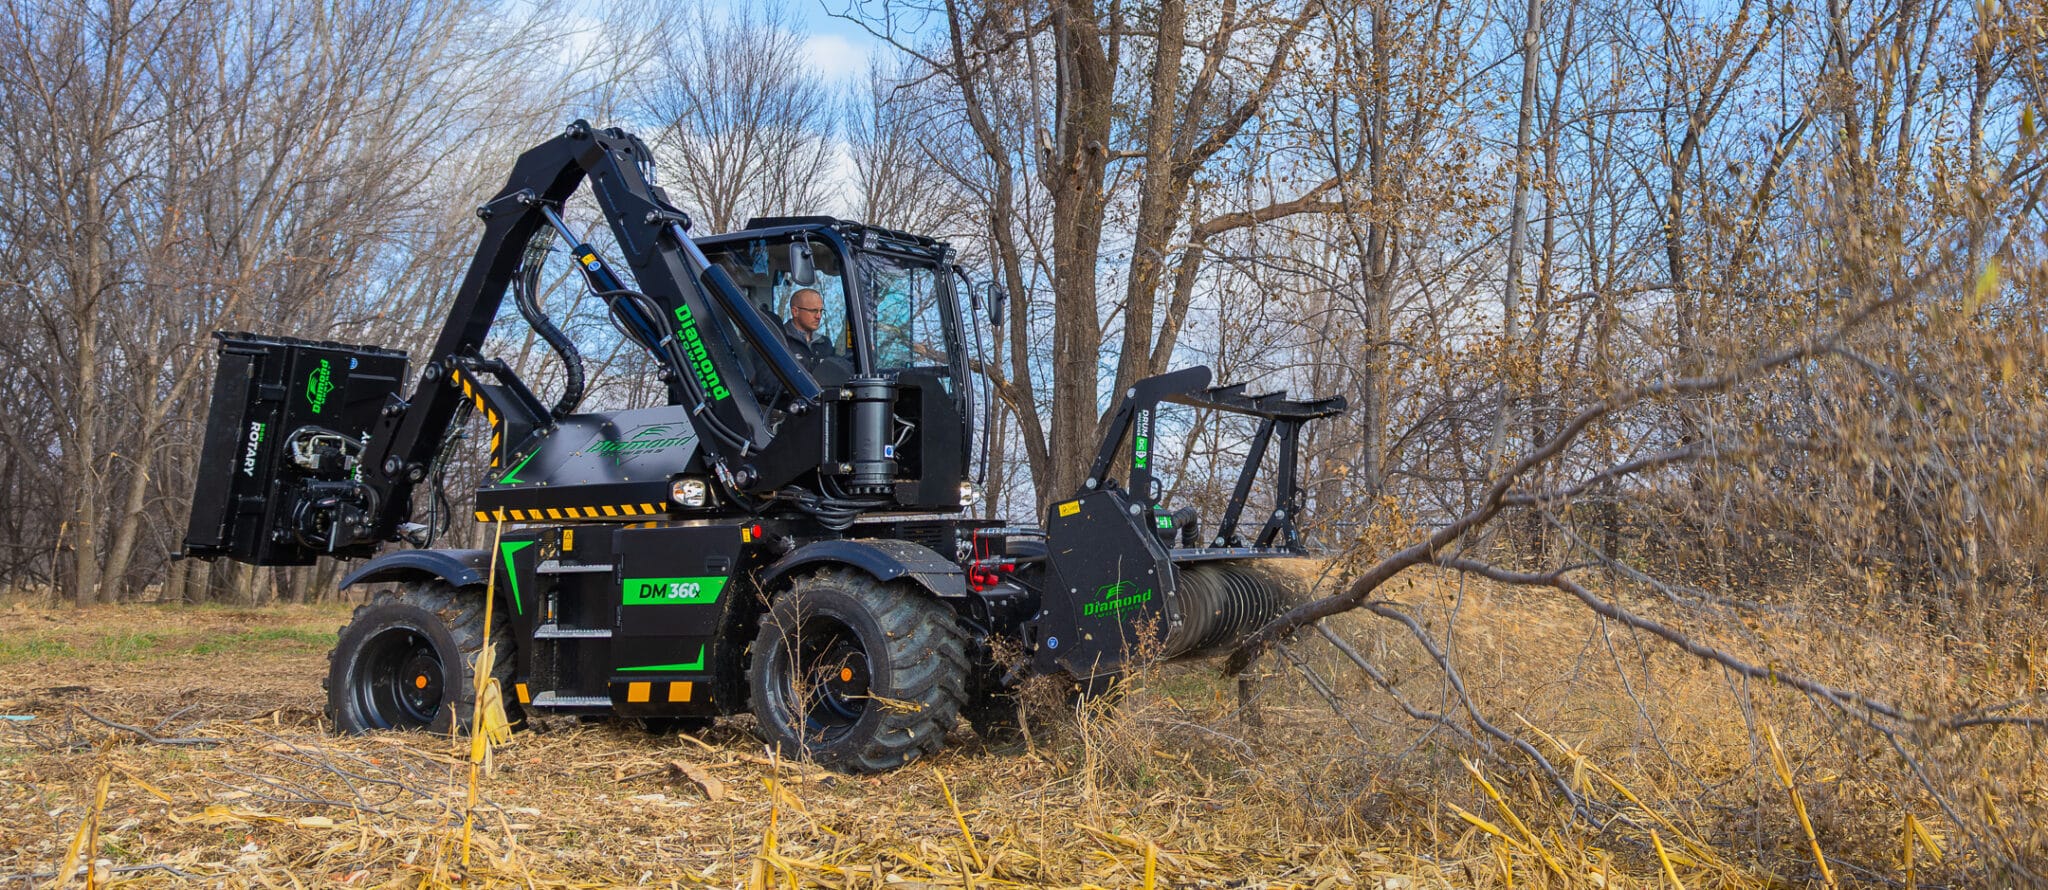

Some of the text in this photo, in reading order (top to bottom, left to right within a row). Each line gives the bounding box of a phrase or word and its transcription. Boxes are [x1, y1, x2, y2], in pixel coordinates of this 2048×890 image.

[674, 303, 730, 401] Diamond
[312, 359, 328, 413] Diamond
[243, 421, 261, 477] ROTARY
[1083, 588, 1152, 616] Diamond
